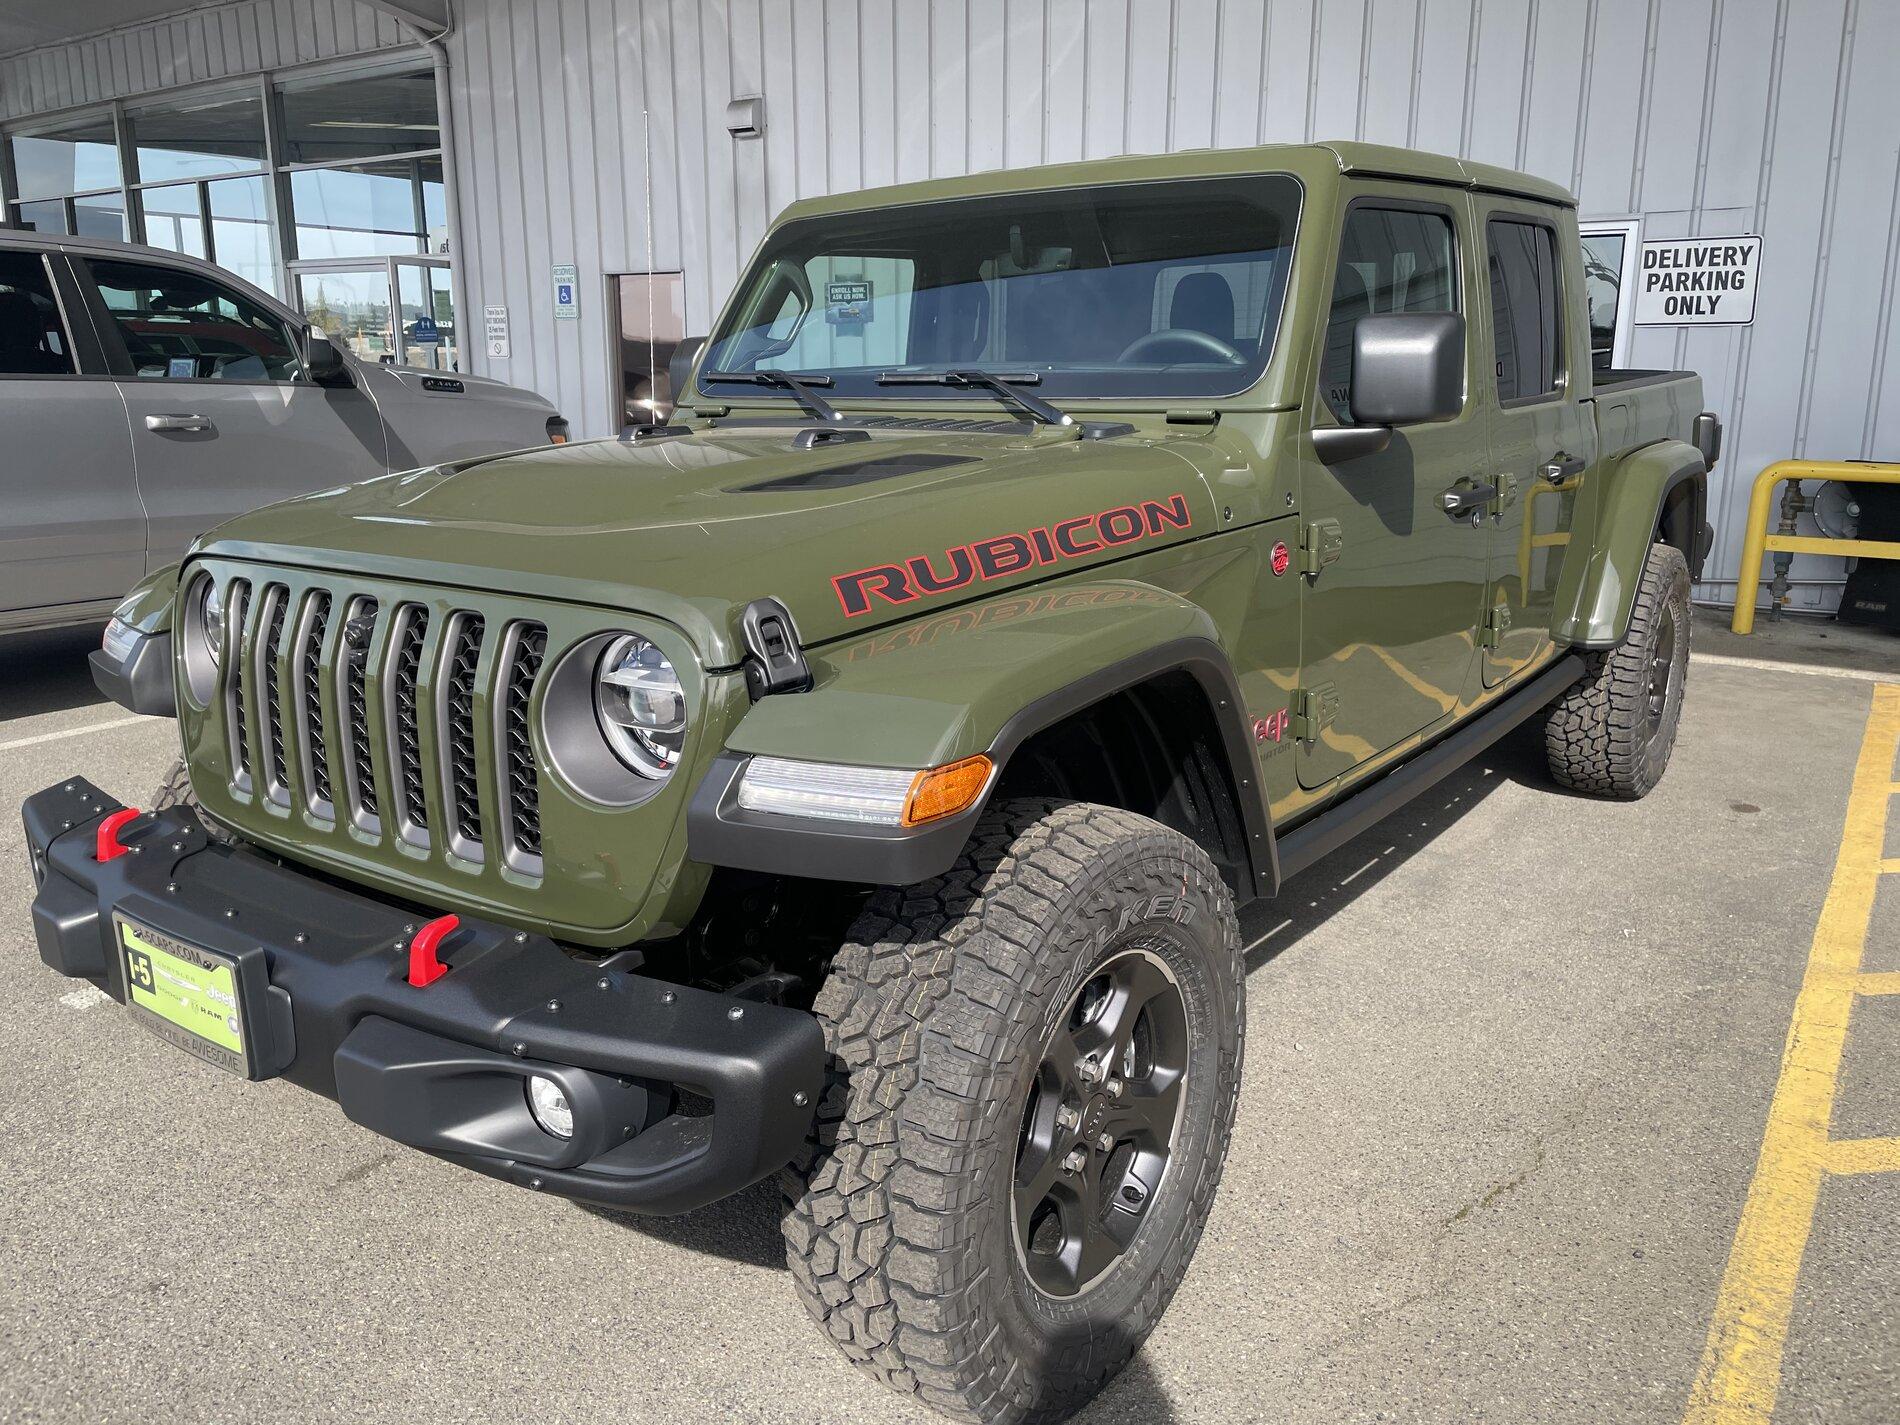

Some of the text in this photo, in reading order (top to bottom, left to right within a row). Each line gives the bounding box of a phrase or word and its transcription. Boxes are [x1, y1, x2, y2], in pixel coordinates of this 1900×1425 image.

[1643, 245, 1753, 269] DELIVERY
[1646, 270, 1745, 292] PARKING
[1664, 295, 1721, 315] ONLY
[830, 493, 1192, 618] RUBICON
[1249, 707, 1289, 744] eep
[128, 951, 151, 986] I-5
[200, 1006, 223, 1021] RAM
